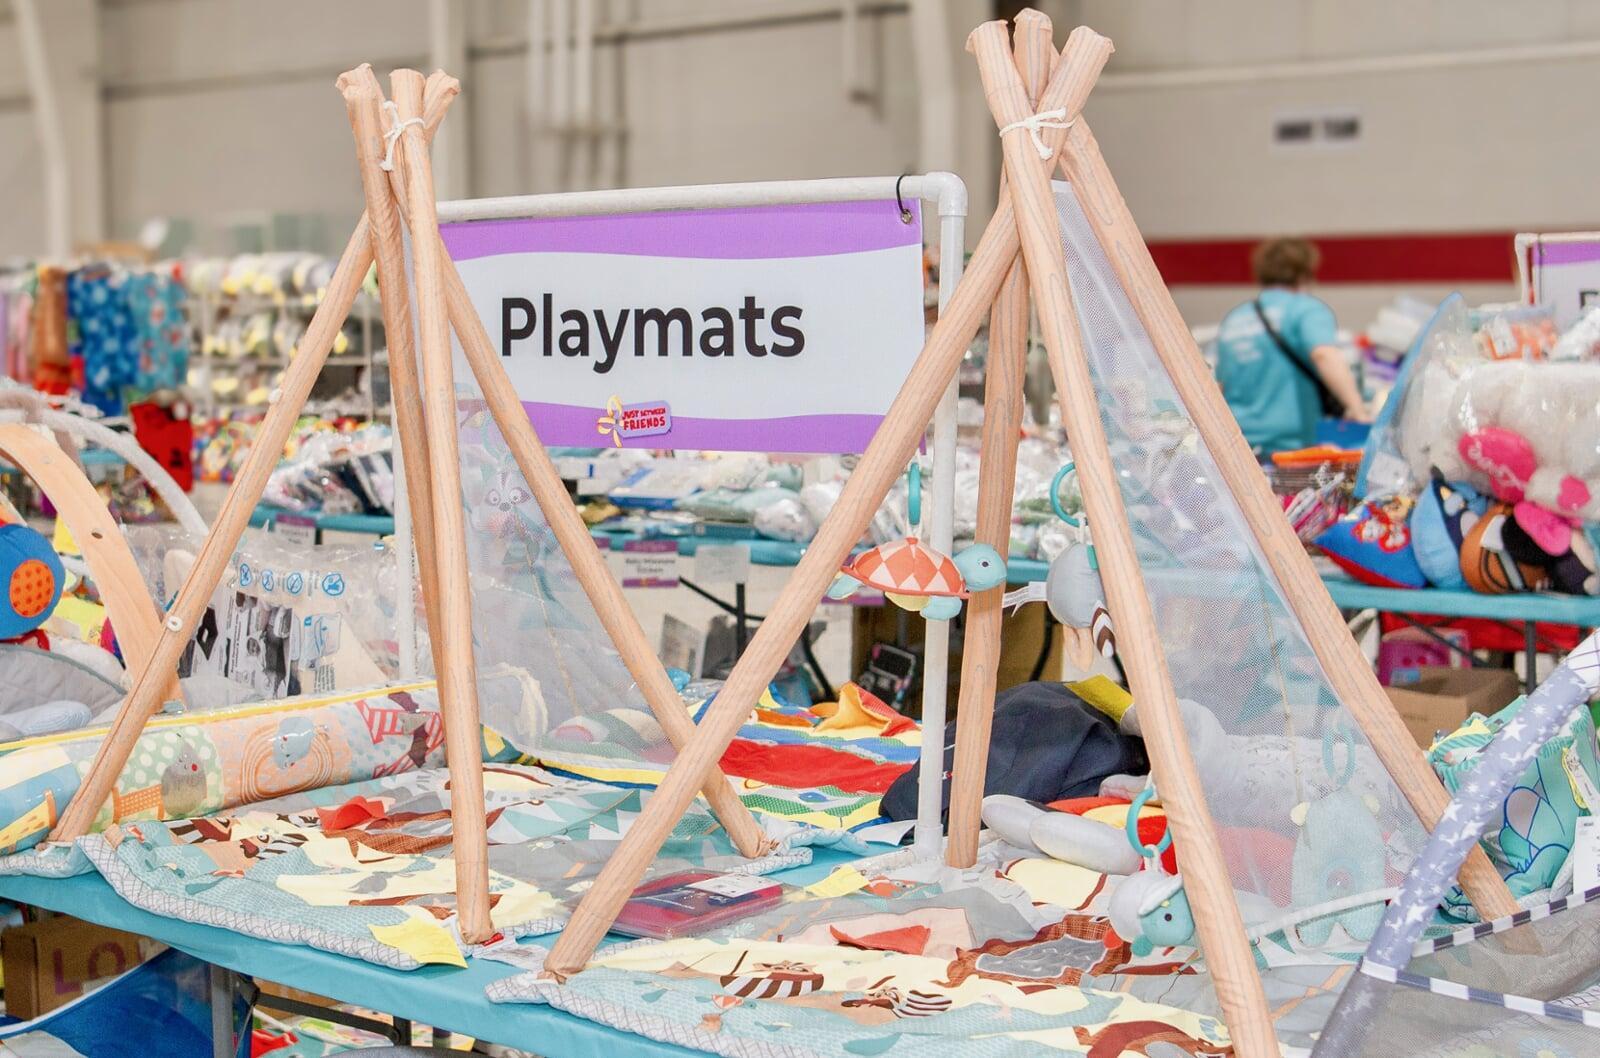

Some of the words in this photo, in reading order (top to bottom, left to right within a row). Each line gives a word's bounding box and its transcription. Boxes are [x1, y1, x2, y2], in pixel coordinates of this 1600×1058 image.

[502, 293, 805, 374] Playmats
[622, 410, 639, 420] JUST
[624, 416, 666, 431] FRIENDS
